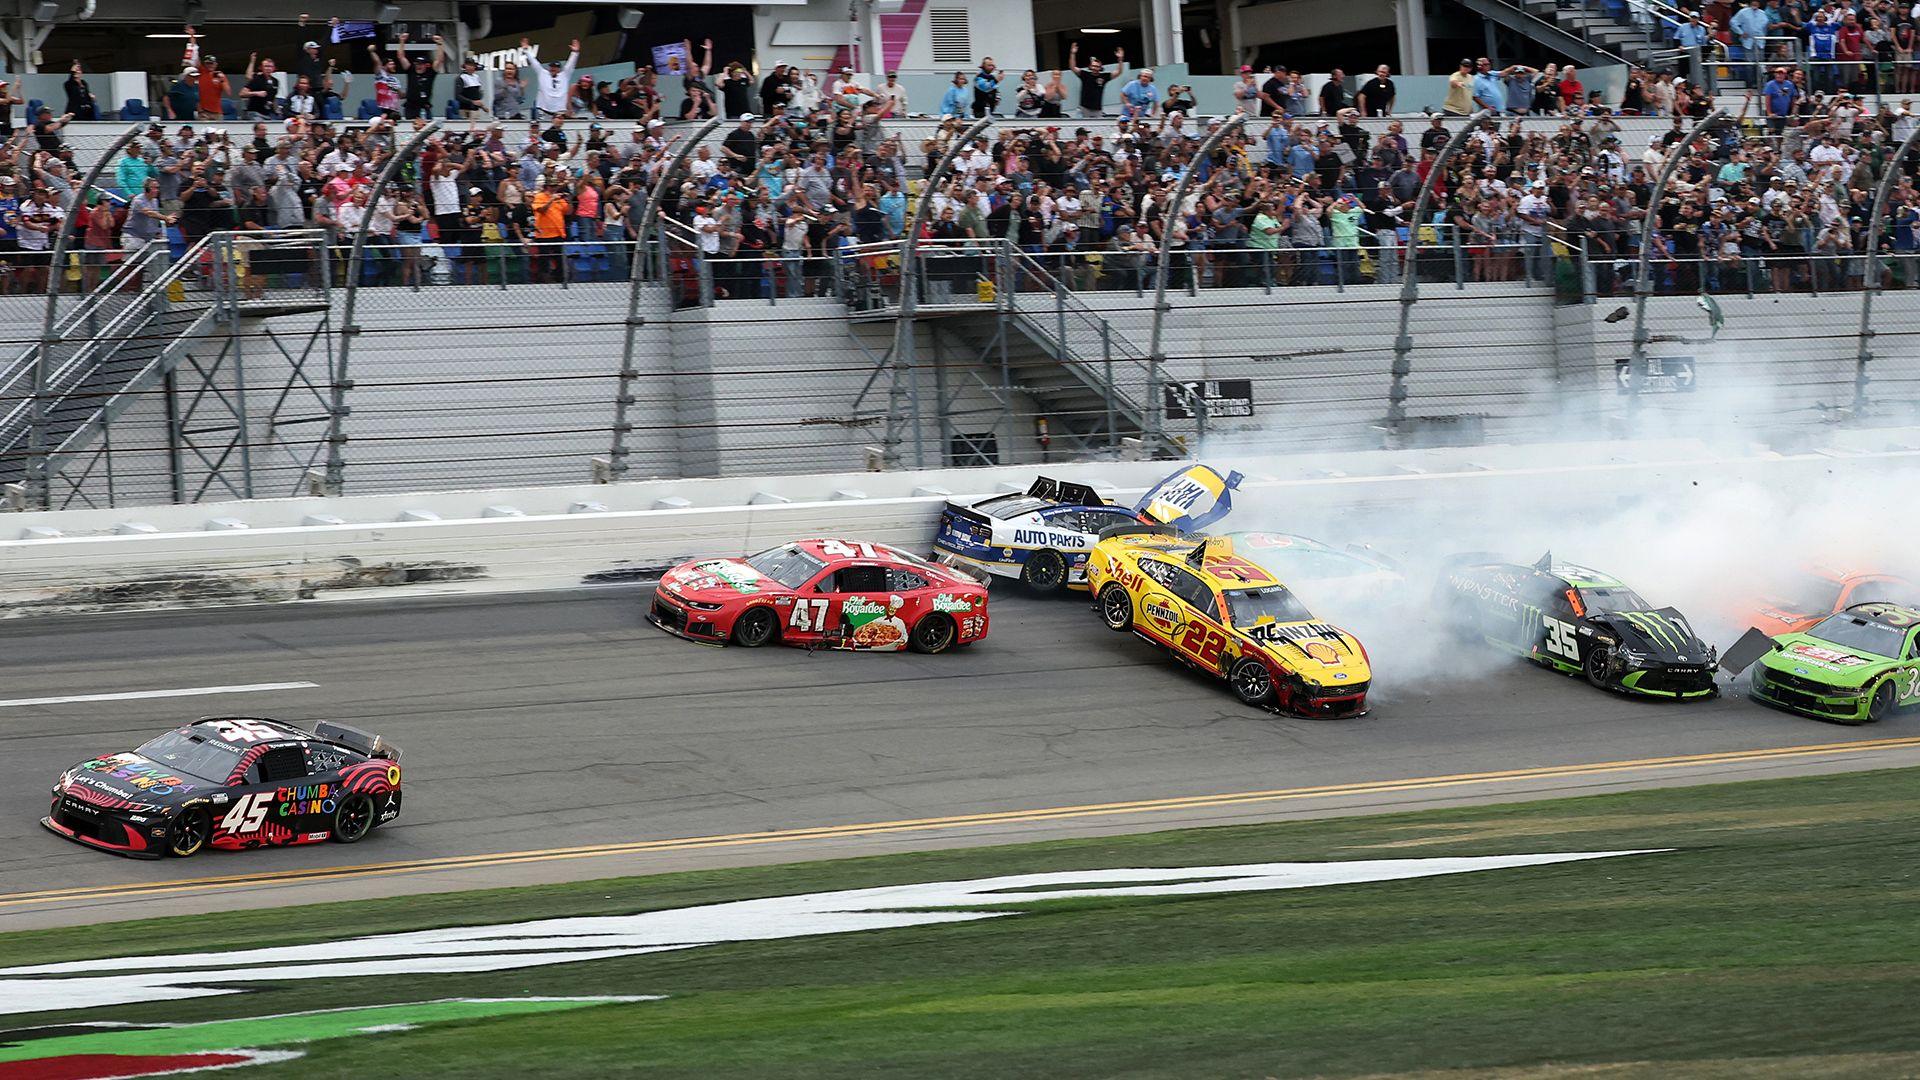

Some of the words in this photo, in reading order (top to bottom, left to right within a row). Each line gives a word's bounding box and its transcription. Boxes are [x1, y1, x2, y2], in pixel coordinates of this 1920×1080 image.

[1014, 528, 1047, 546] AUTO
[1049, 531, 1085, 548] PARTS
[817, 539, 878, 558] 47
[1105, 556, 1145, 593] Shell
[842, 601, 886, 615] Boyardee
[849, 595, 866, 606] Chef
[933, 598, 972, 612] Boyardee
[938, 593, 953, 603] Chef
[789, 598, 829, 632] 47
[1147, 603, 1179, 623] PENNZOIL
[1181, 620, 1226, 664] 22
[1543, 614, 1580, 661] 35
[207, 719, 283, 742] 45
[208, 739, 240, 753] REDDICK
[75, 774, 96, 786] Let's
[94, 779, 133, 800] Chumba!
[277, 782, 340, 802] CHUMBA
[65, 799, 100, 816] CAMRY
[221, 791, 275, 834] 45
[279, 798, 337, 817] CASINO
